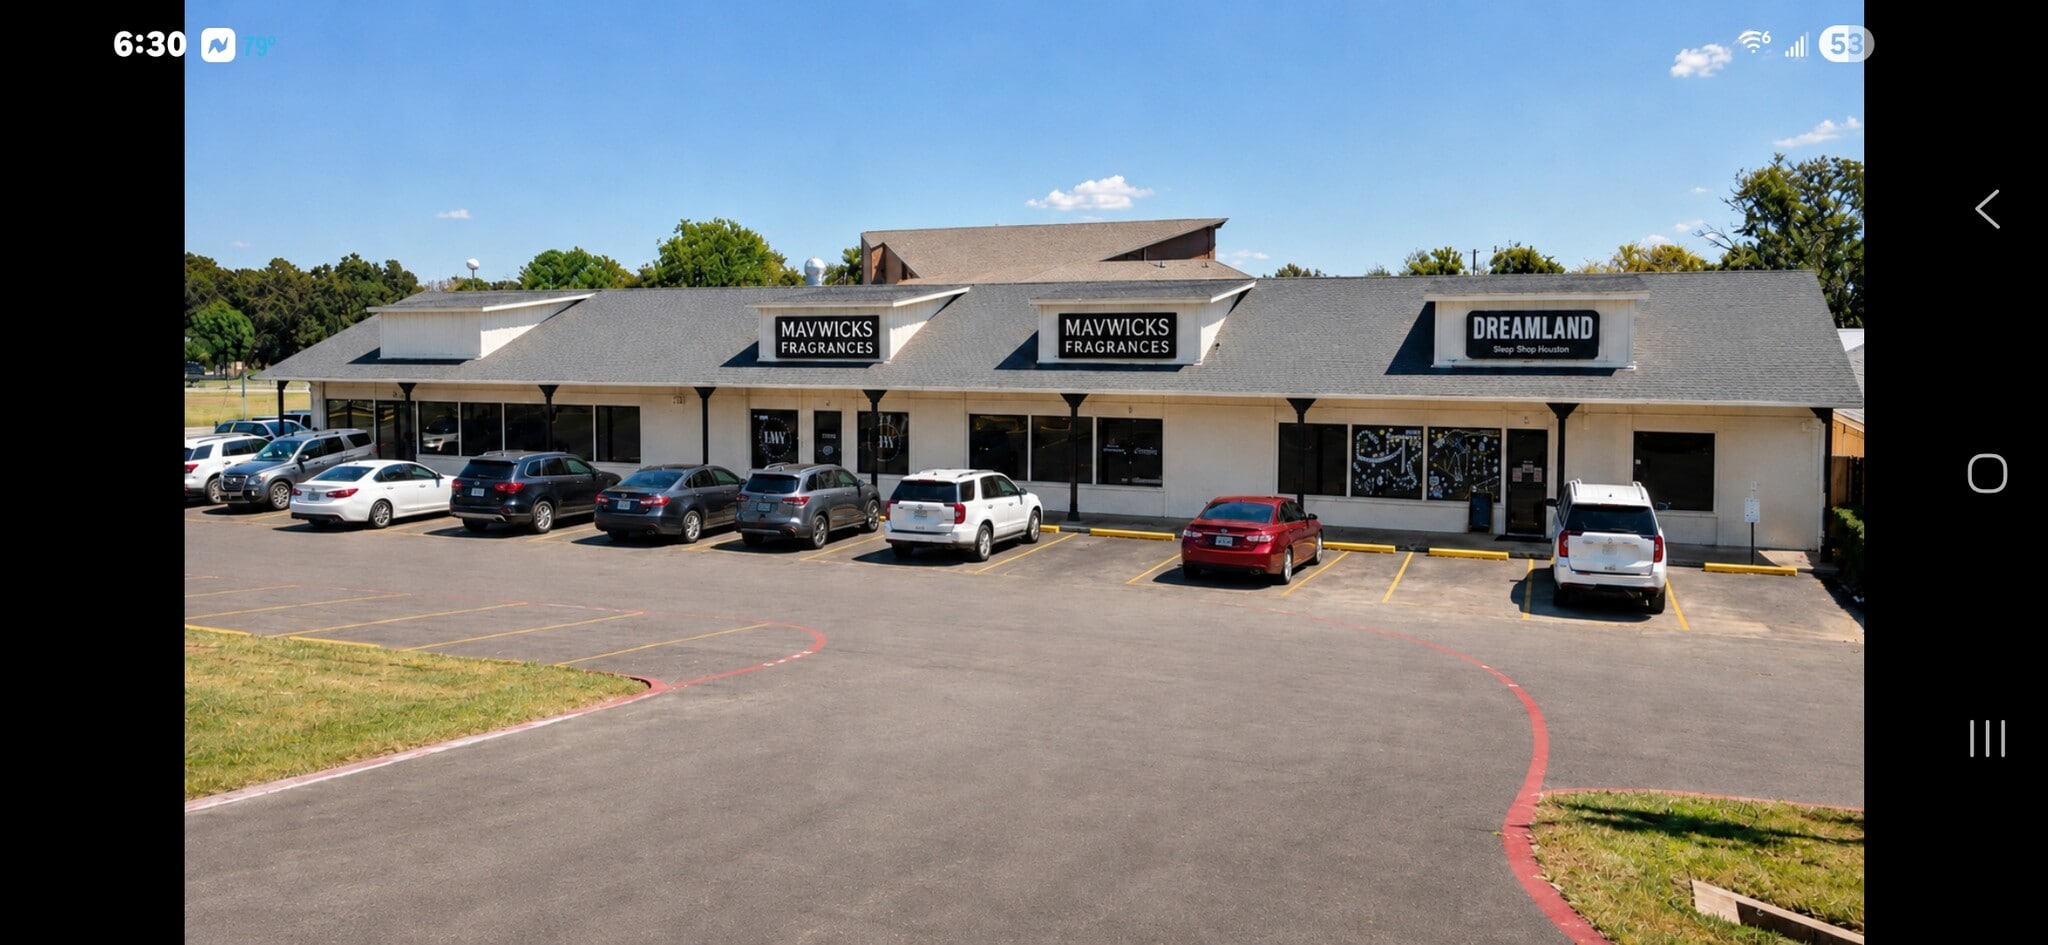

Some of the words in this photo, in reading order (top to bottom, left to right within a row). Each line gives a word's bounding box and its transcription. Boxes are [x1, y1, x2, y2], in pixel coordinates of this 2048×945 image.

[781, 320, 873, 338] MAVWICKS
[1065, 318, 1170, 336] MAVWICKS
[1473, 315, 1594, 340] DREAMLAND
[781, 341, 873, 354] FRAGRANCES
[1065, 340, 1170, 354] FRAGRANCES
[1516, 345, 1537, 355] Shop
[1538, 345, 1570, 353] Houston
